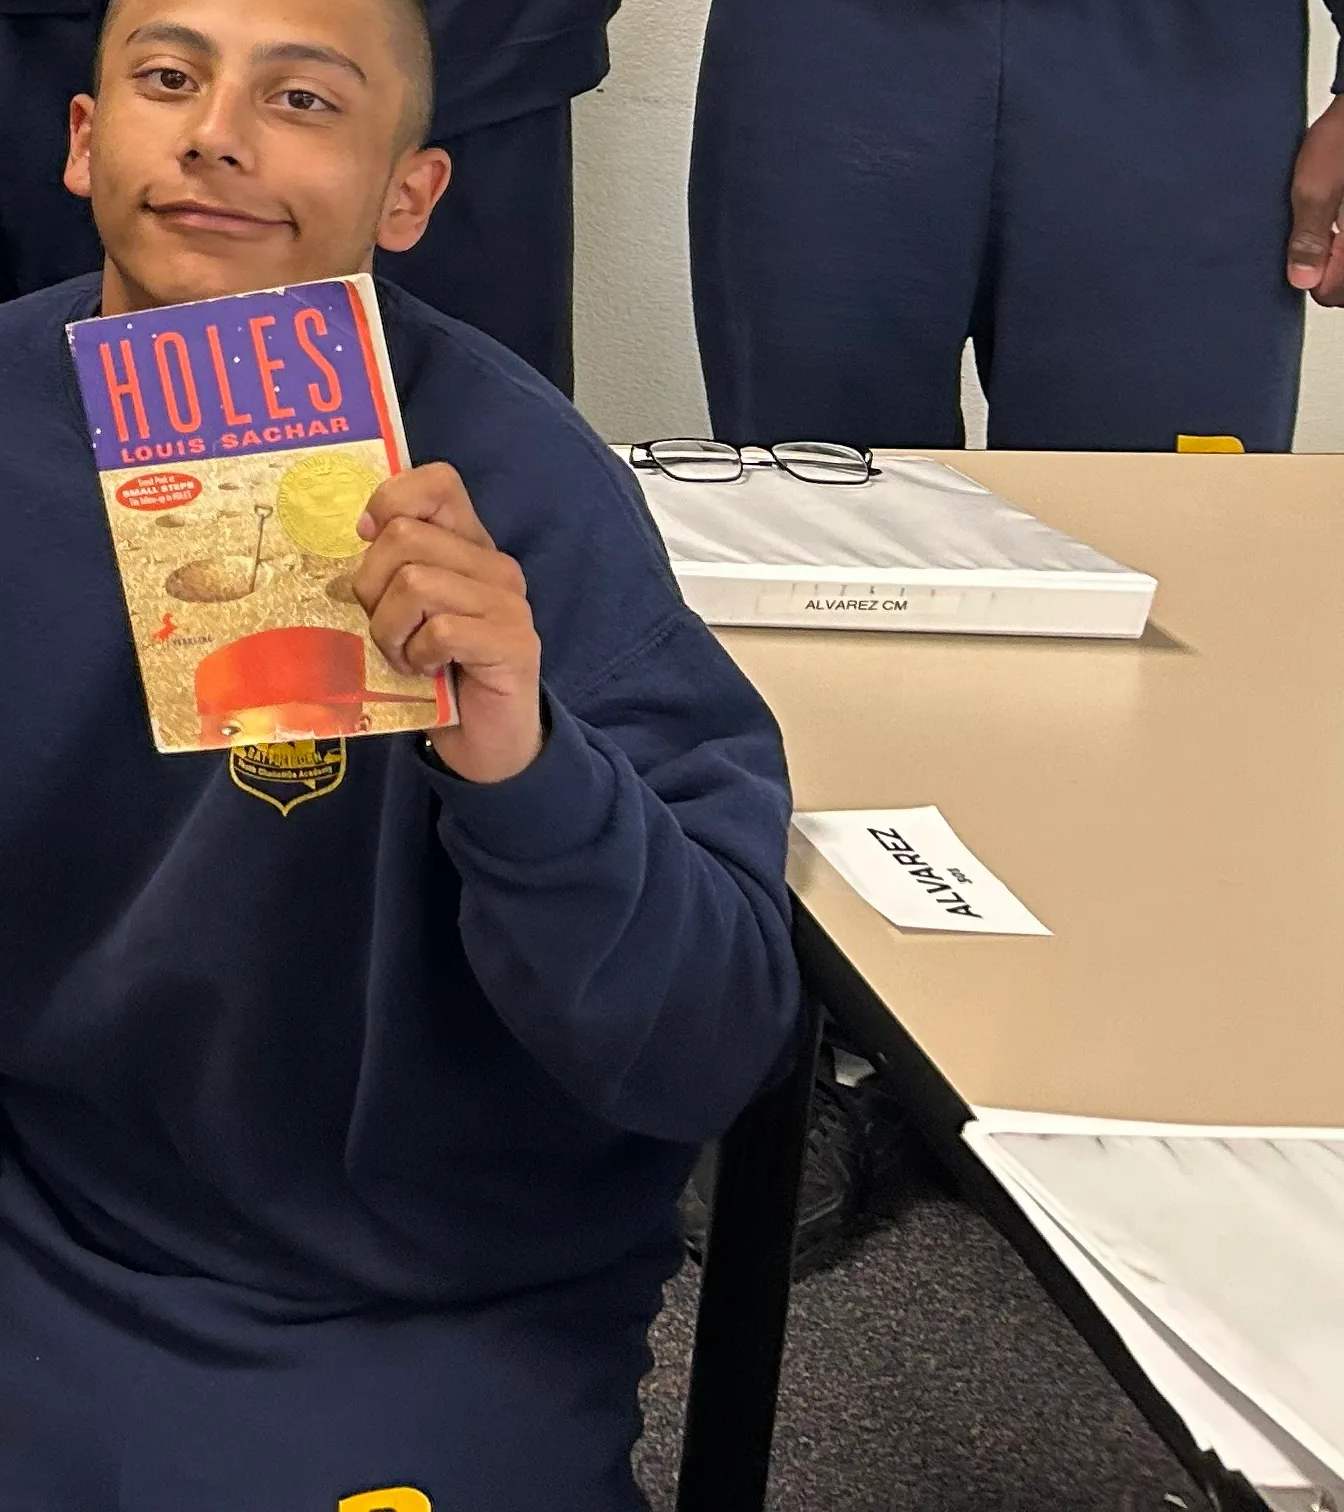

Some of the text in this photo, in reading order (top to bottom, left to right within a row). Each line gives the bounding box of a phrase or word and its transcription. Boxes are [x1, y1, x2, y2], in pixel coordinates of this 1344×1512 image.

[99, 307, 344, 443] HOLES
[120, 415, 352, 464] LOUIS SACHAR
[805, 598, 909, 612] ALVAREZ CM
[867, 827, 983, 919] ALVAREZ
